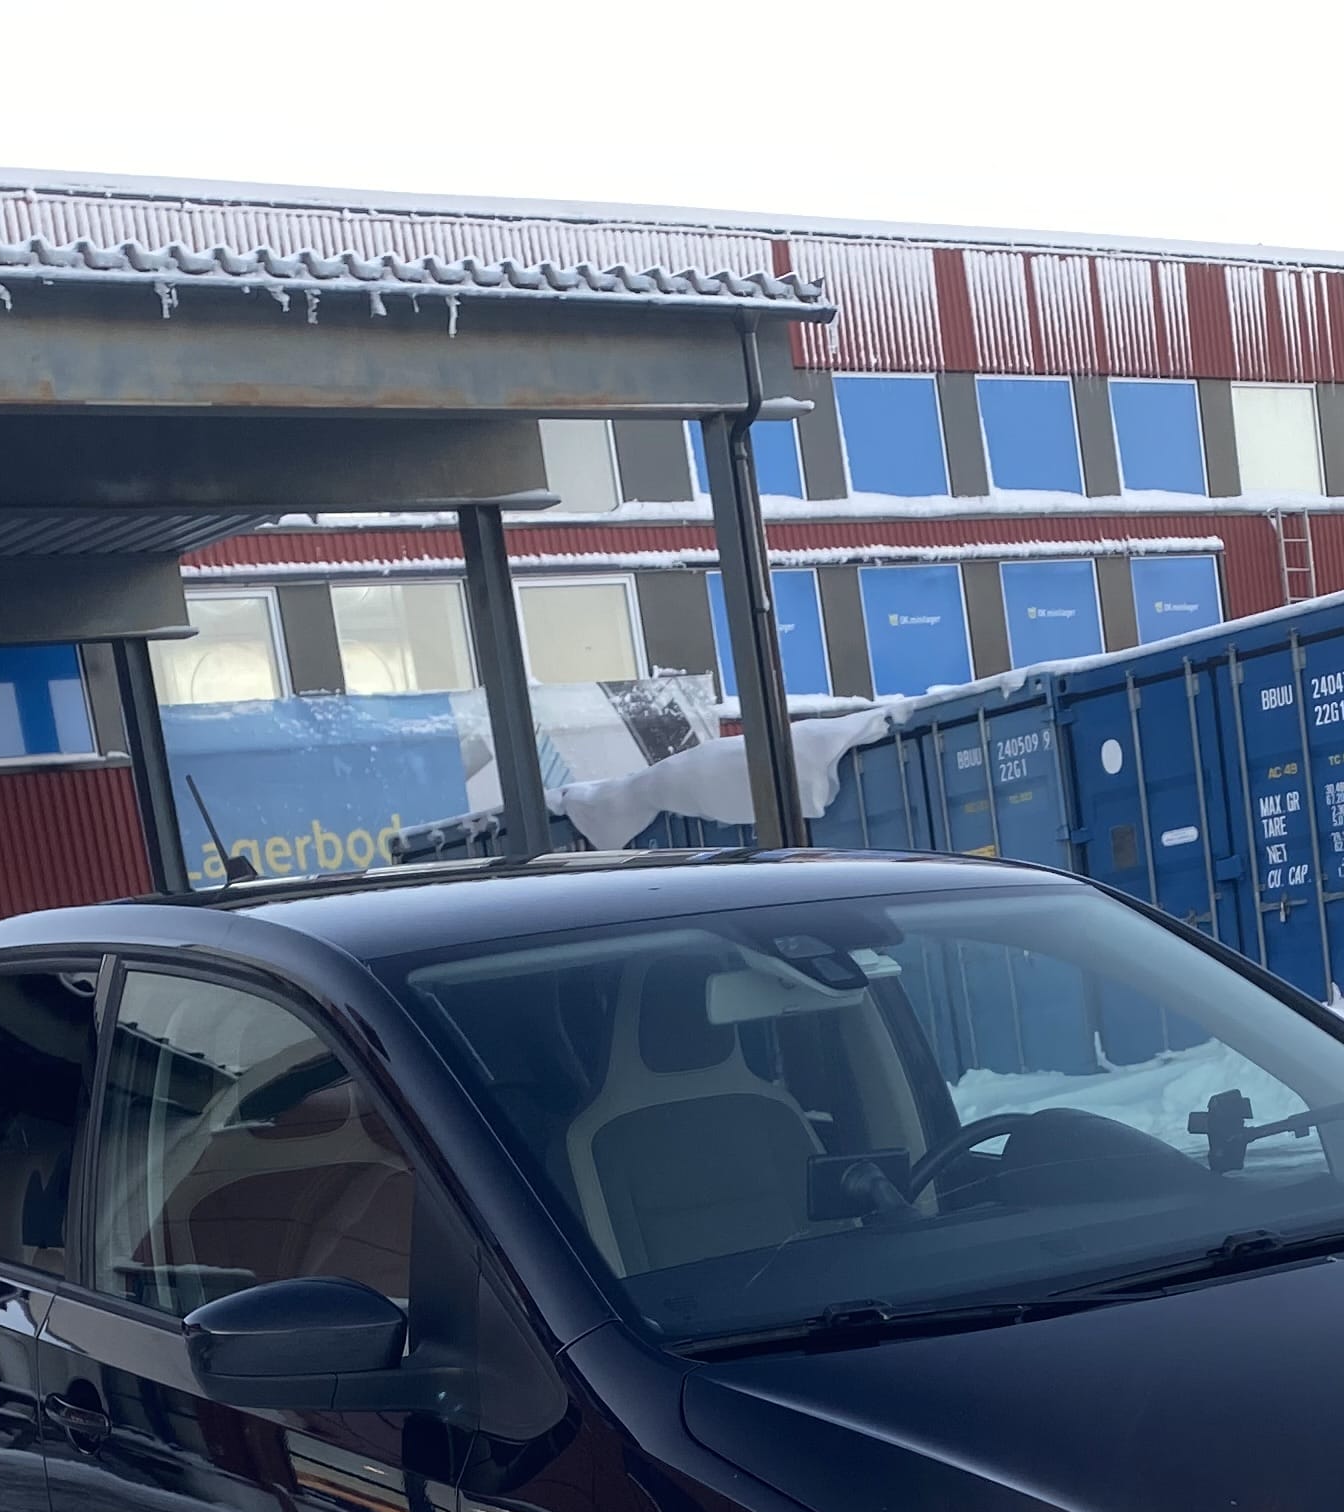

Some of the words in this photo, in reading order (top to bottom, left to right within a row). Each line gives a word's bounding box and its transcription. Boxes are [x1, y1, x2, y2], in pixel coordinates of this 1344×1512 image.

[1260, 684, 1294, 711] BBUU
[957, 747, 983, 770] BBUU
[997, 732, 1039, 761] 240509
[1042, 730, 1051, 751] 9
[1328, 754, 1341, 766] TC
[999, 758, 1028, 783] 22G1
[1286, 791, 1301, 812] GR
[1261, 815, 1288, 839] TARE
[1266, 843, 1288, 865] NET
